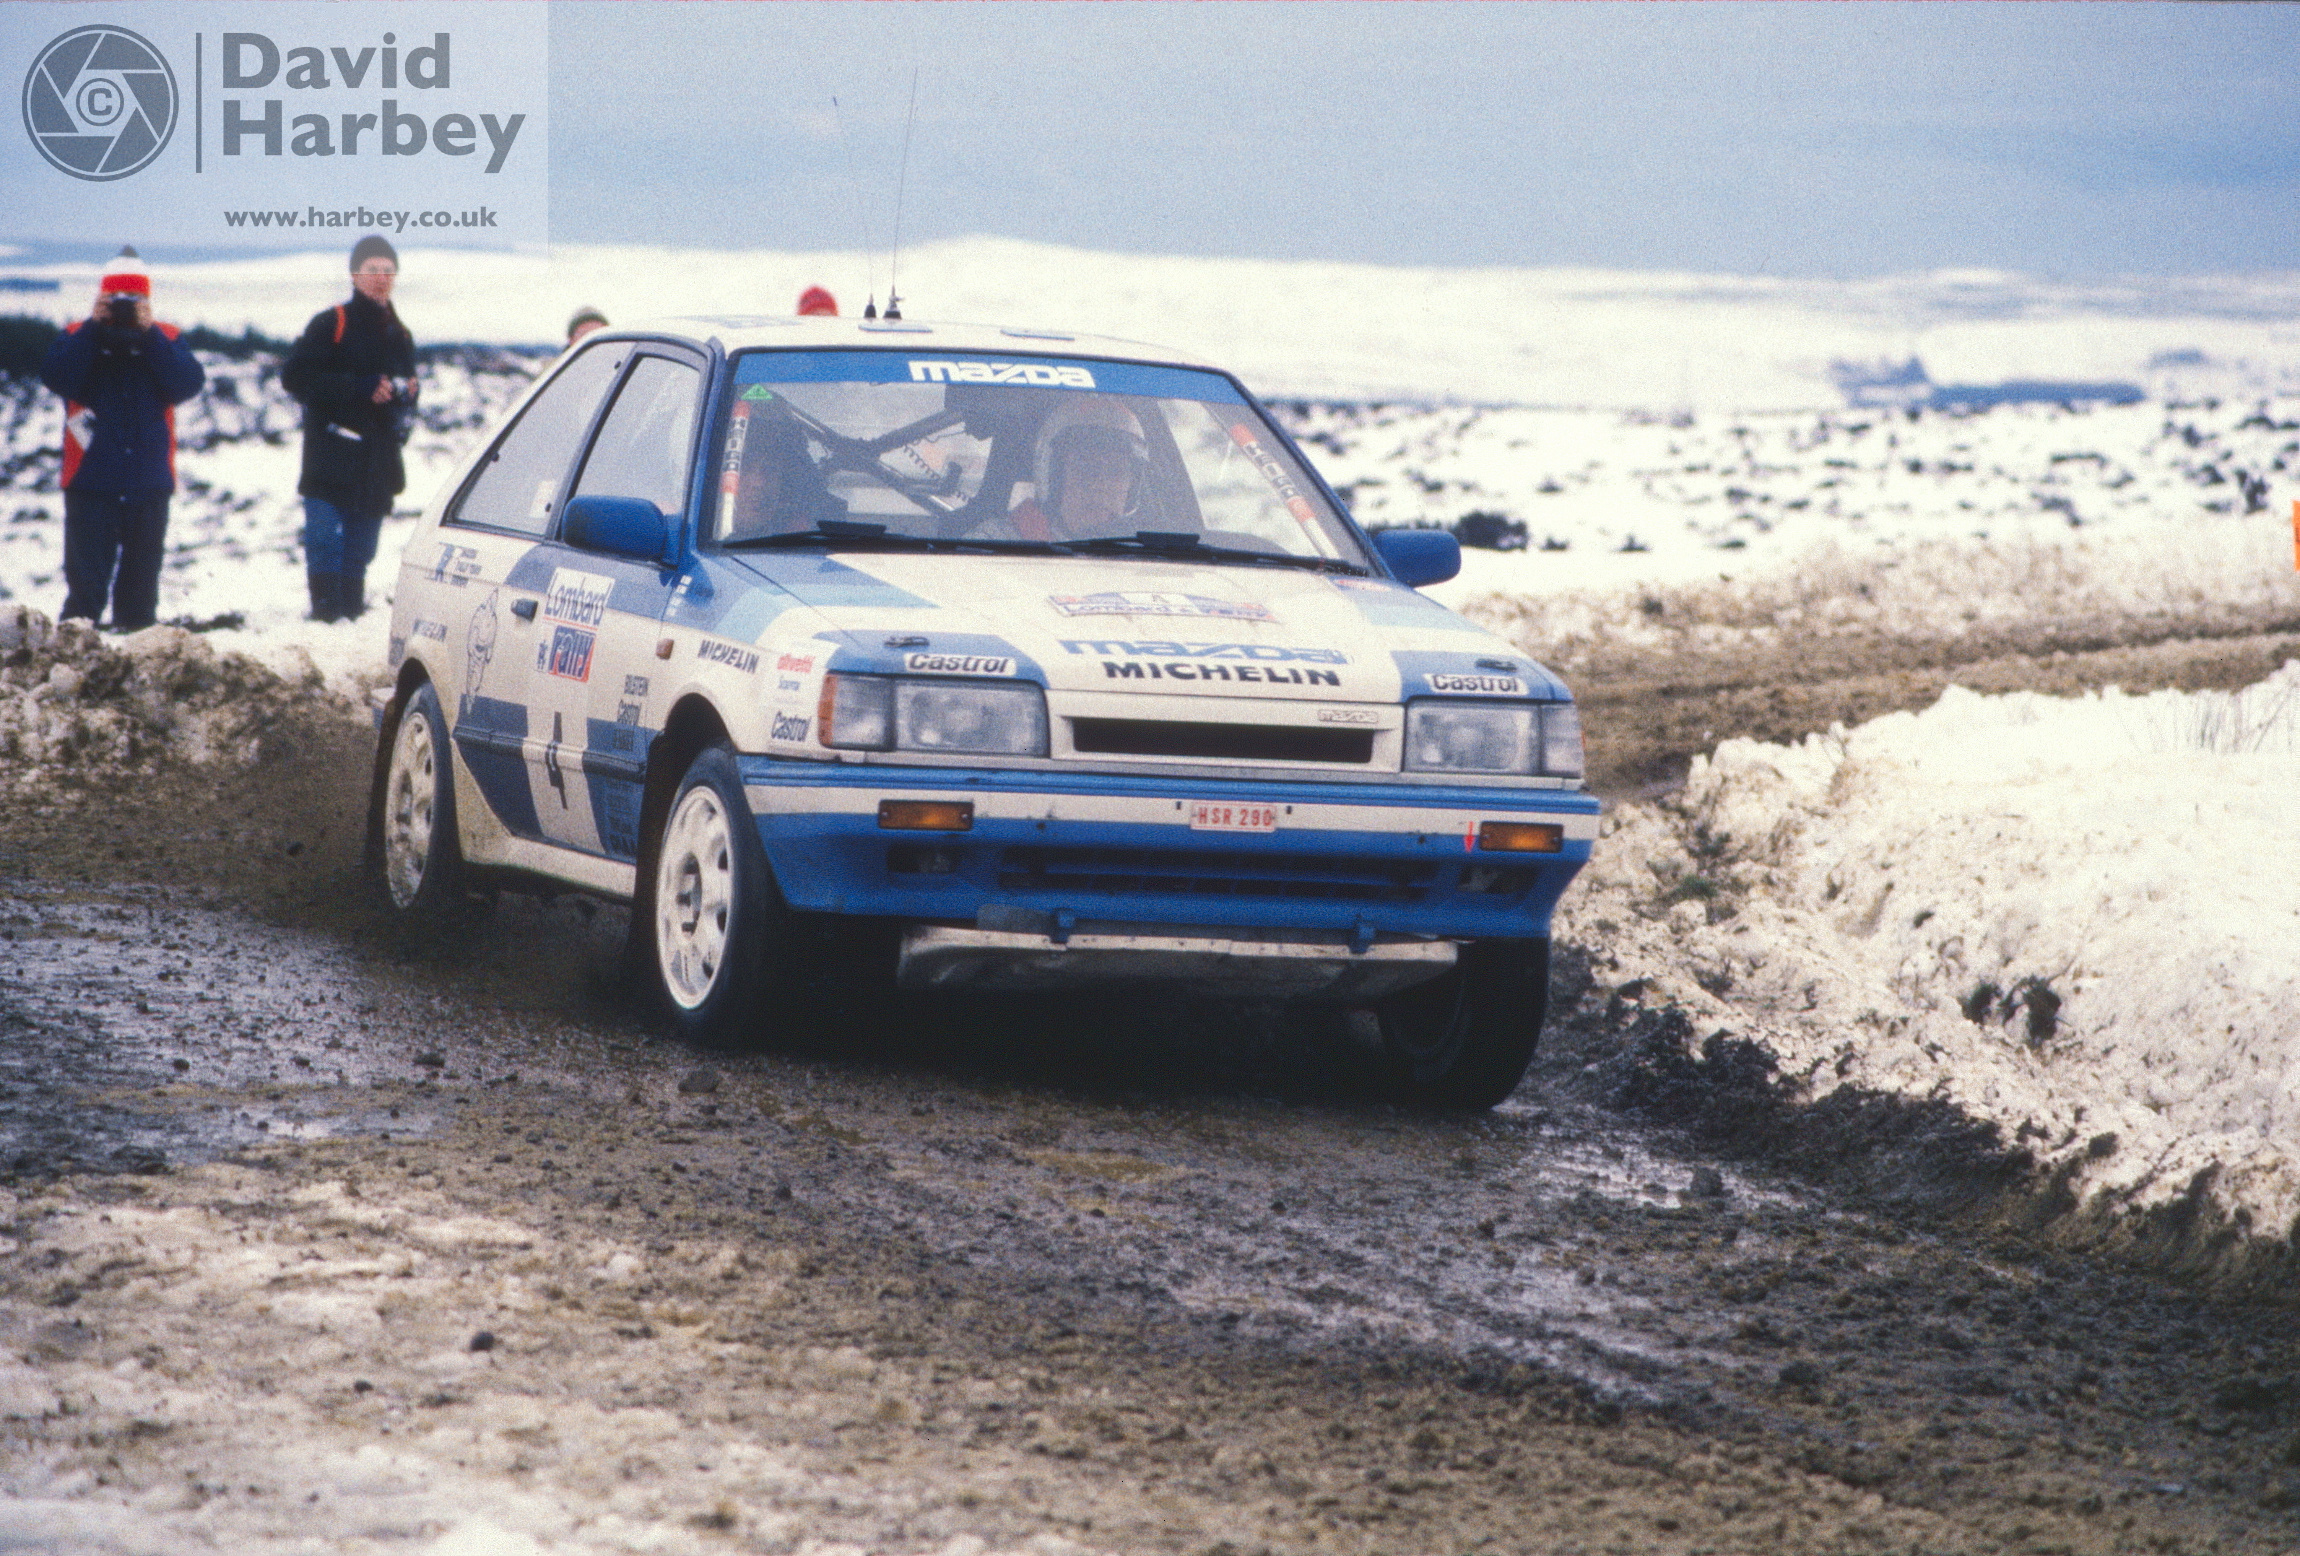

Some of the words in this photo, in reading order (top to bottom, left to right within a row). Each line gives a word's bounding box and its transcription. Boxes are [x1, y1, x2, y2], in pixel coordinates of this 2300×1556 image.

[544, 571, 612, 626] Lombard
[697, 639, 760, 674] MICHELIN
[909, 654, 1009, 673] Castrol
[1102, 661, 1342, 687] MICHELIN
[1432, 674, 1518, 692] Castrol
[545, 711, 568, 810] 4
[1198, 806, 1232, 825] HSR
